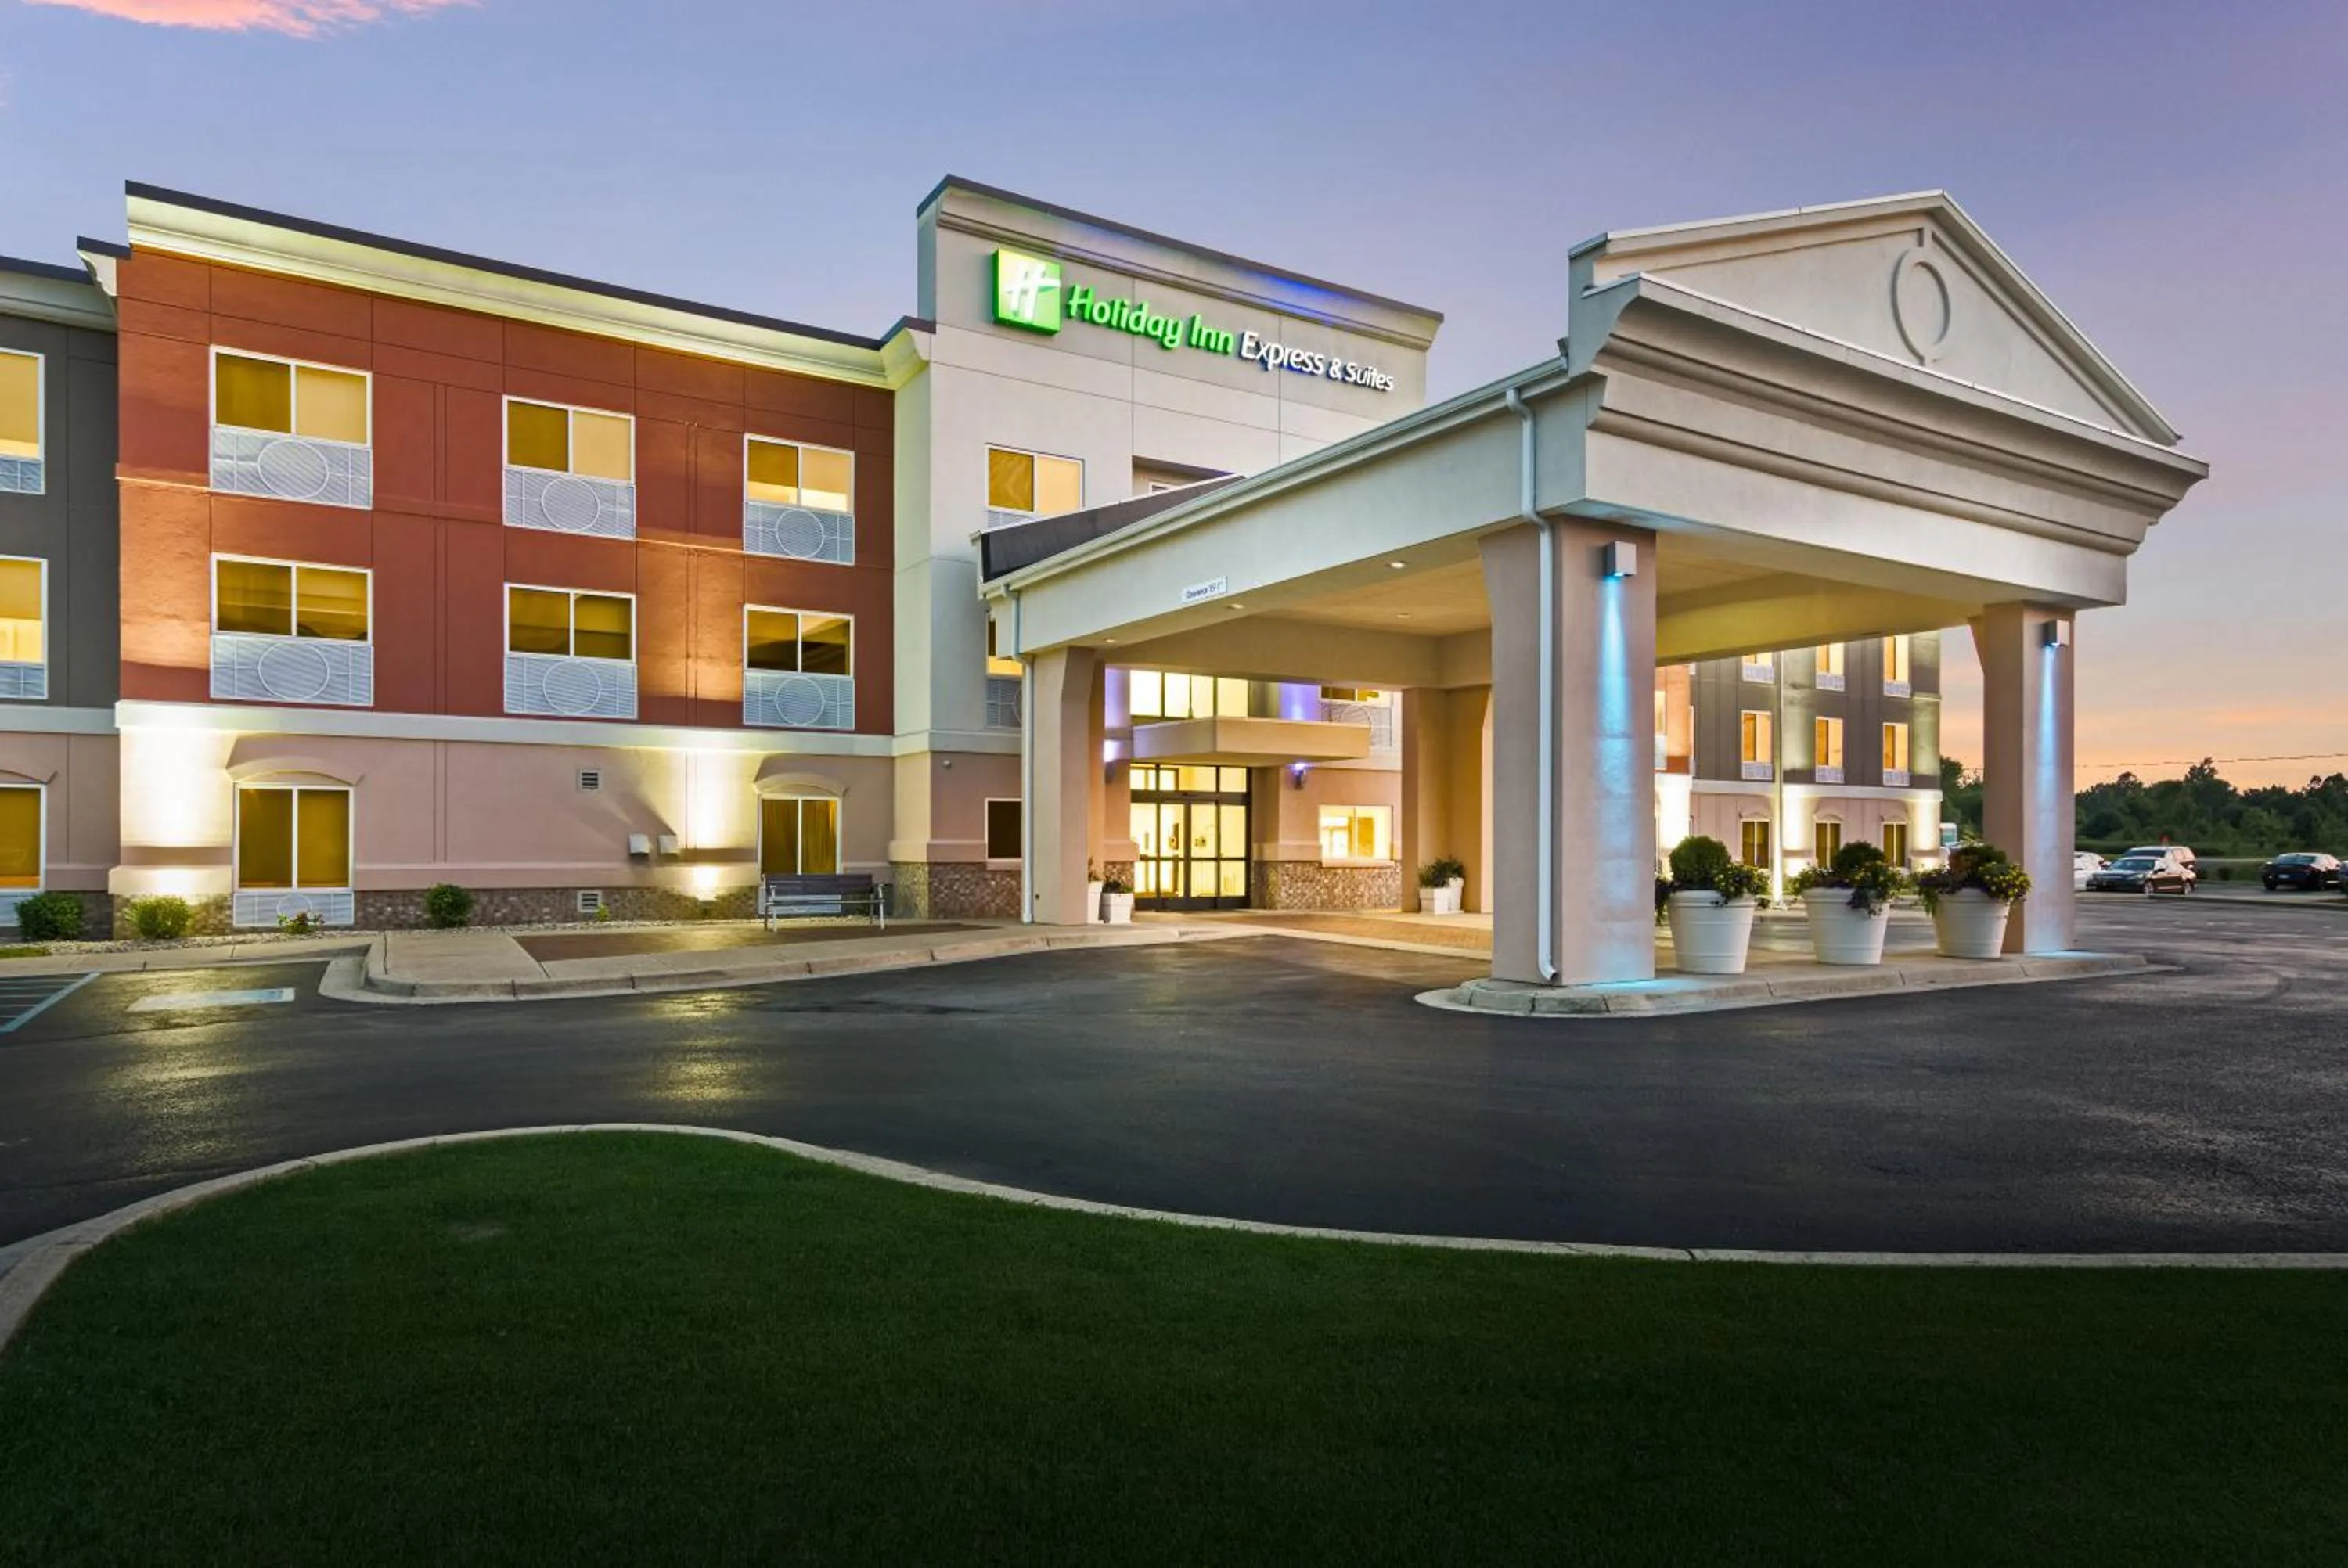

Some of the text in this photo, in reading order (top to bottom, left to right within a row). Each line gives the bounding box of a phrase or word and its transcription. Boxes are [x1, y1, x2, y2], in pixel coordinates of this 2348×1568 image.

[1066, 283, 1395, 392] Holiday Inn Express & Suites
